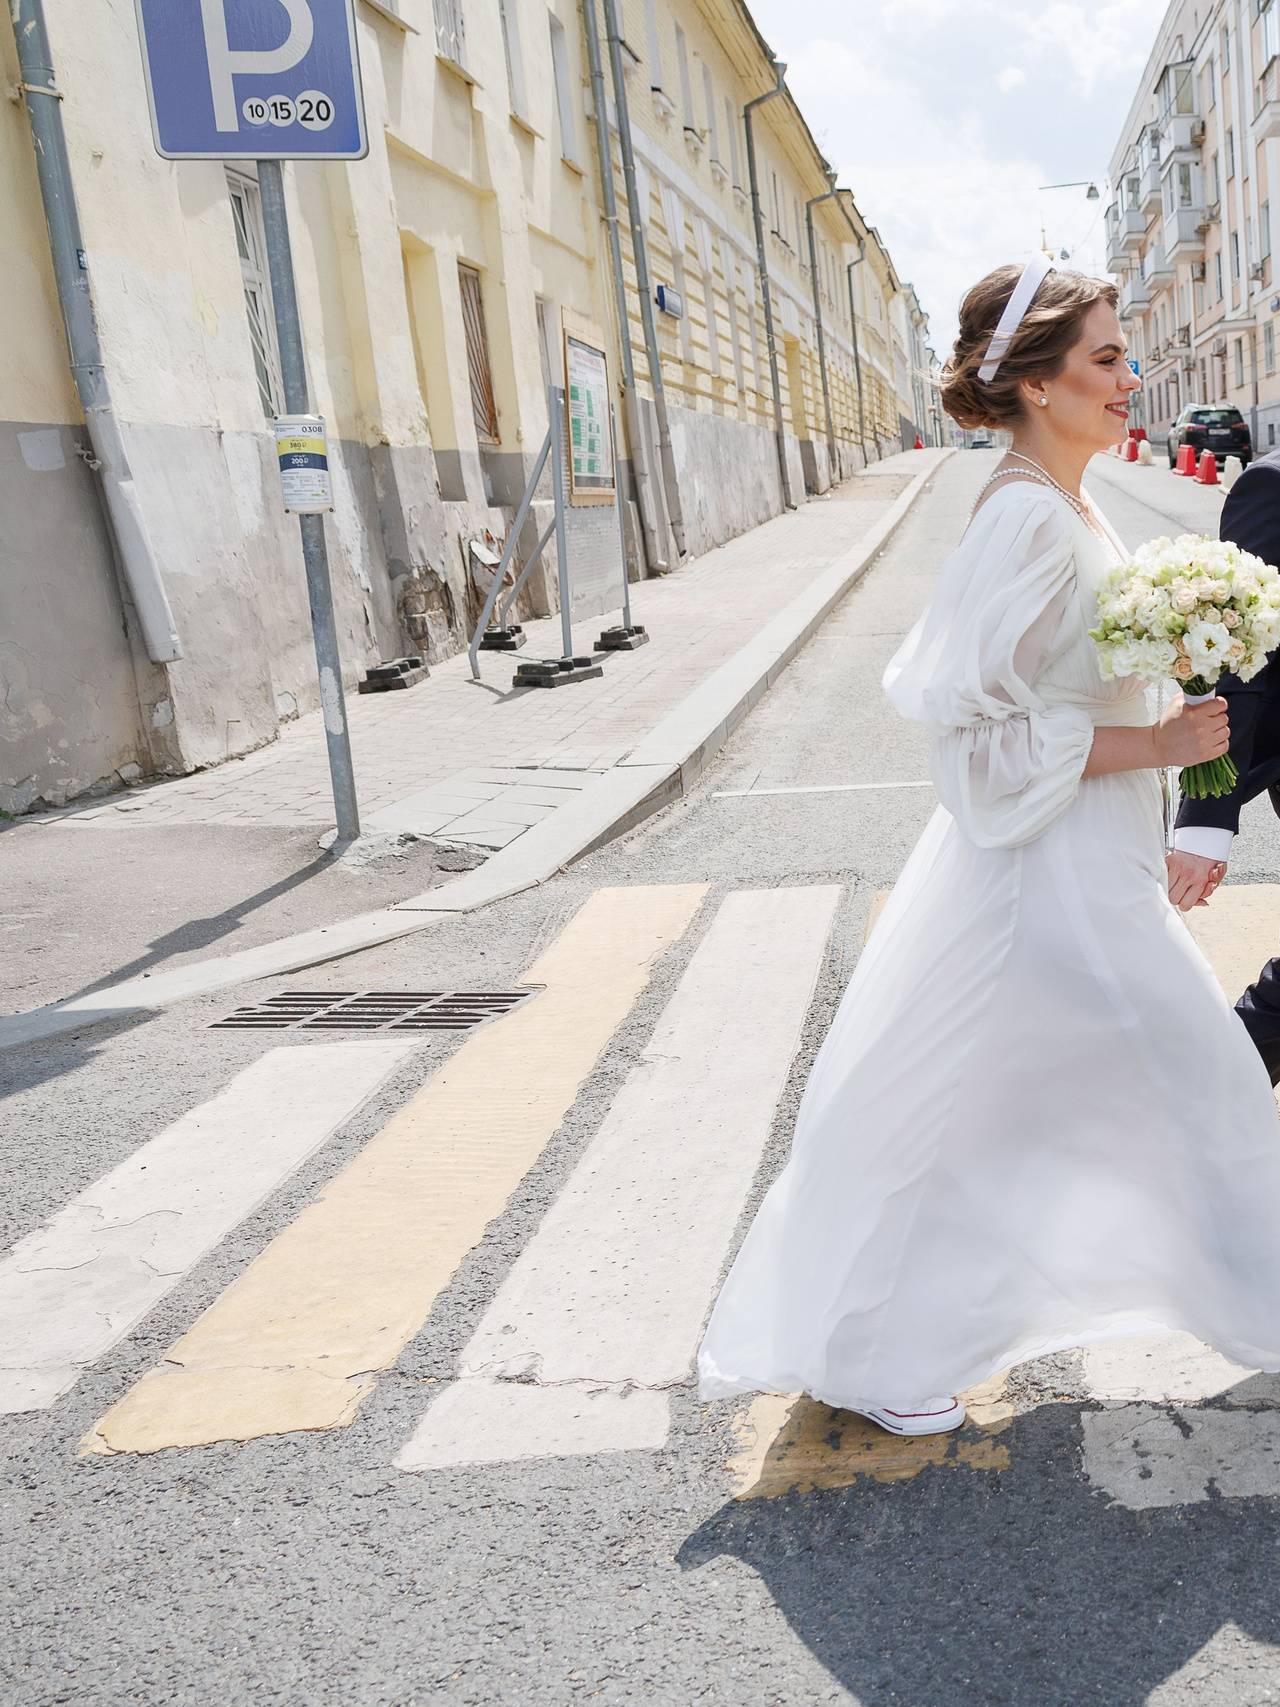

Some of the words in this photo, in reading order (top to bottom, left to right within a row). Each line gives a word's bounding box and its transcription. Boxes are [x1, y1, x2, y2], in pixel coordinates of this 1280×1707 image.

[200, 0, 314, 132] P
[248, 104, 264, 118] 10
[270, 102, 291, 120] 15
[299, 100, 331, 122] 20
